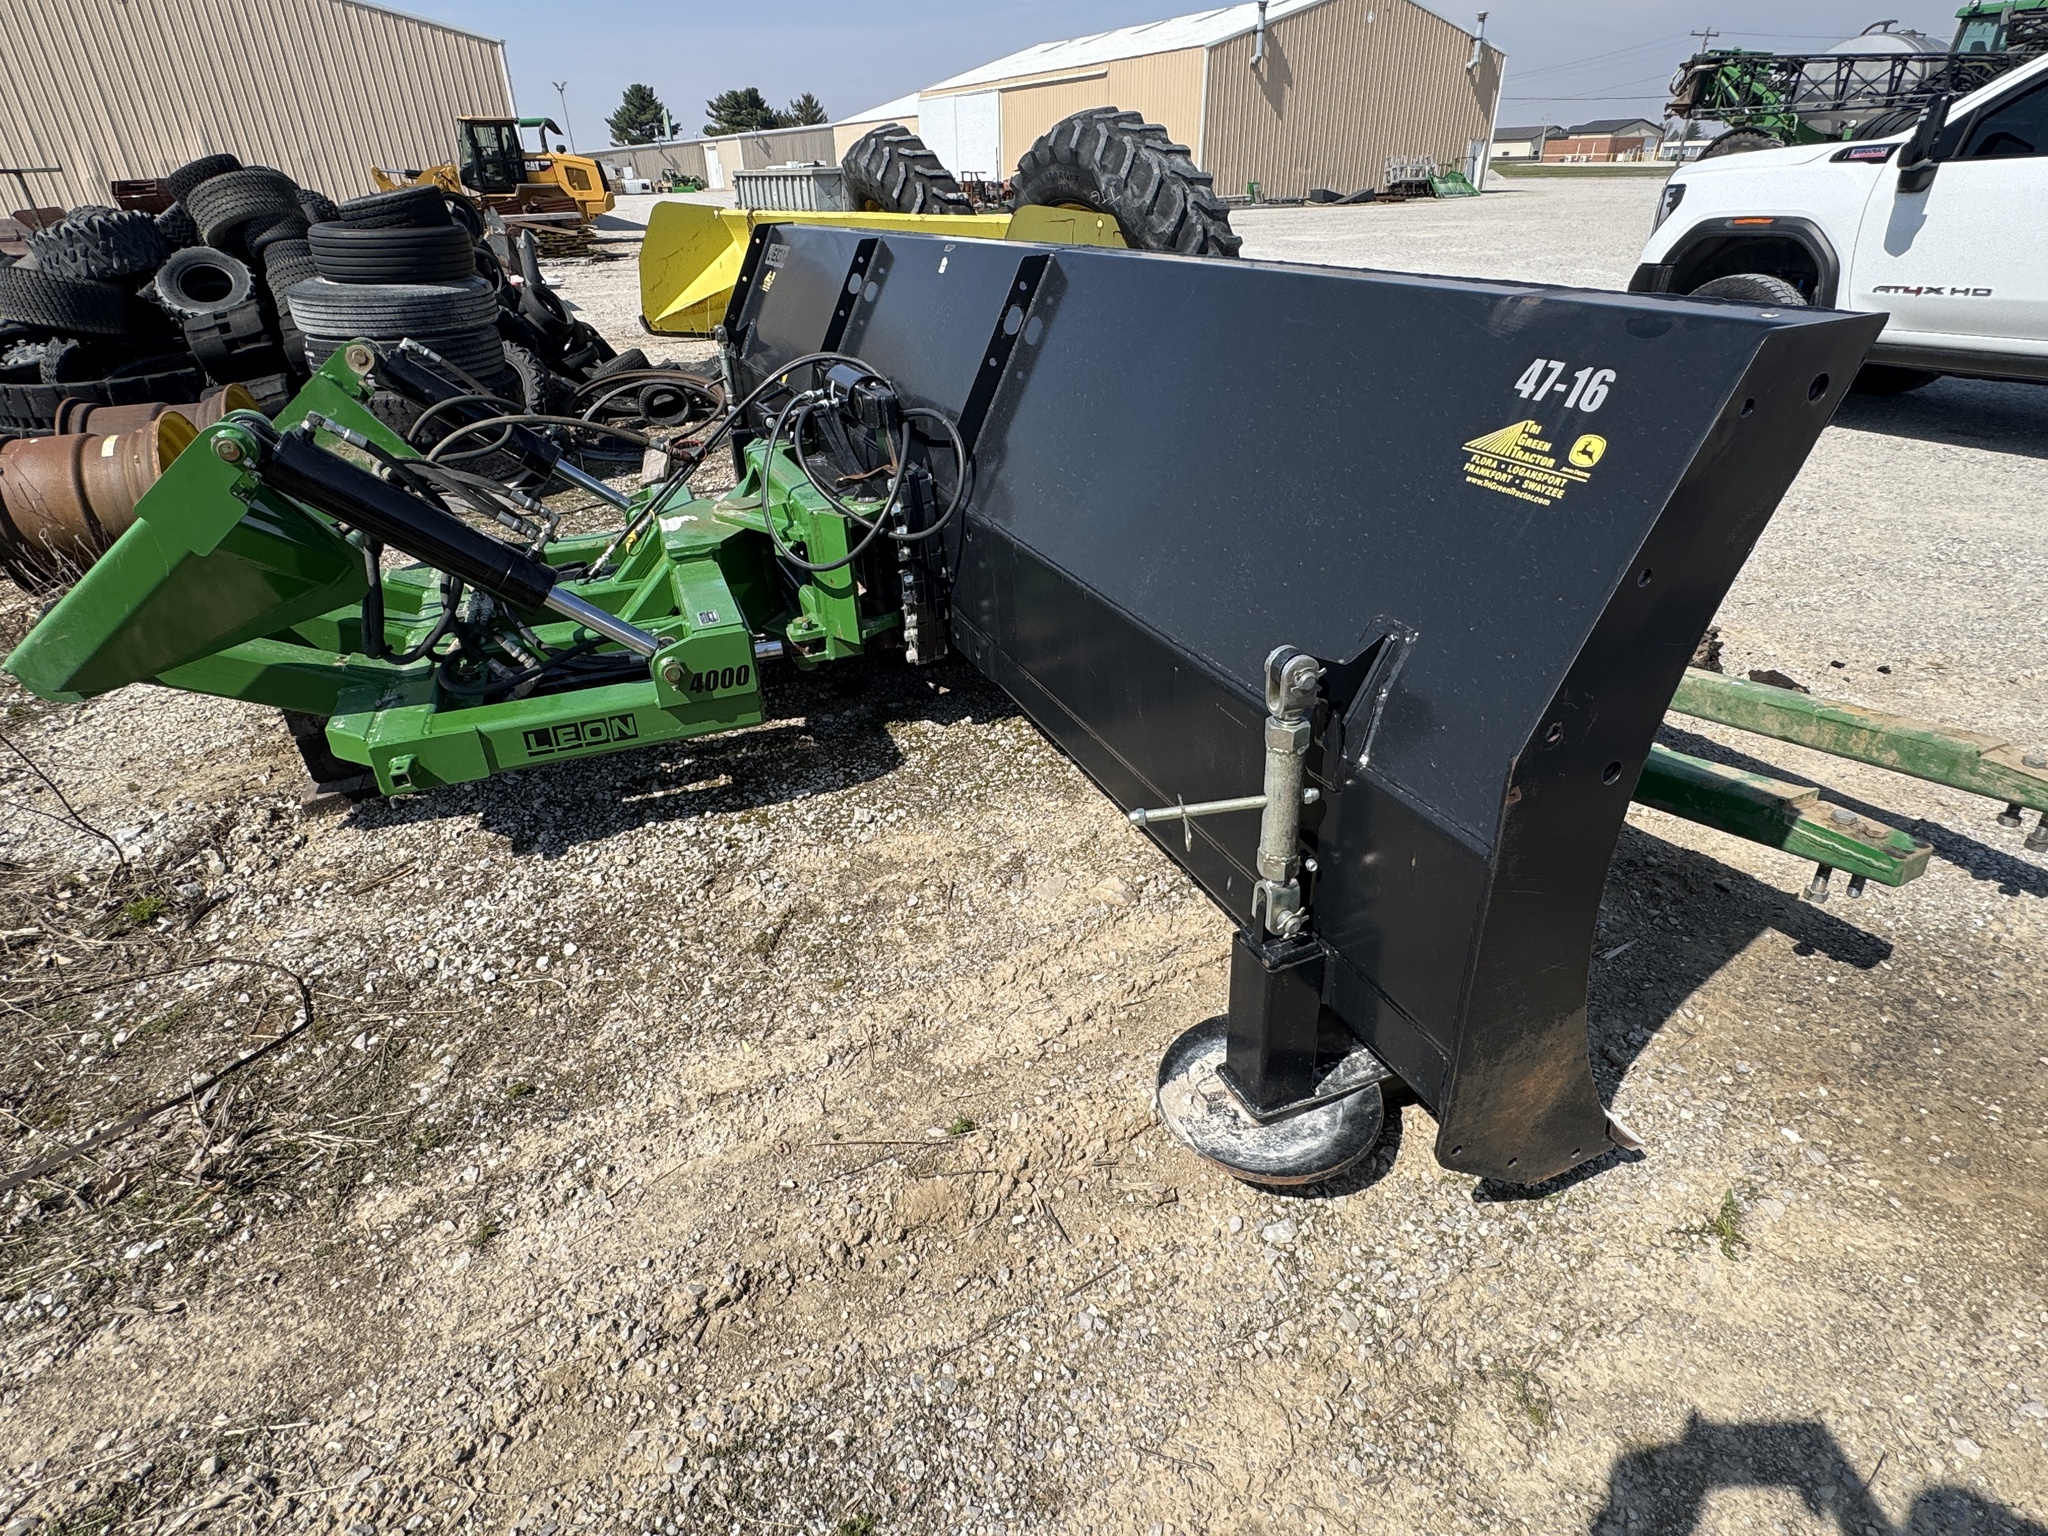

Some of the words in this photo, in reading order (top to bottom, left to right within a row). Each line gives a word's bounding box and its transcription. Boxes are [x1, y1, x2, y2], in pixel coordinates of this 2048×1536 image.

[524, 160, 540, 171] CAT
[1872, 285, 1945, 297] AT4X
[1950, 287, 1993, 297] HD
[1514, 358, 1617, 413] 47-16
[1463, 463, 1513, 484] FRANKFORT
[1521, 480, 1565, 499] SWAYZEE
[1471, 454, 1498, 469] FLORA
[1507, 464, 1568, 488] LOGANSPORT
[1465, 475, 1551, 506] www.TriGreenTractor.com
[689, 664, 750, 694] 4000
[523, 713, 639, 757] LEON
